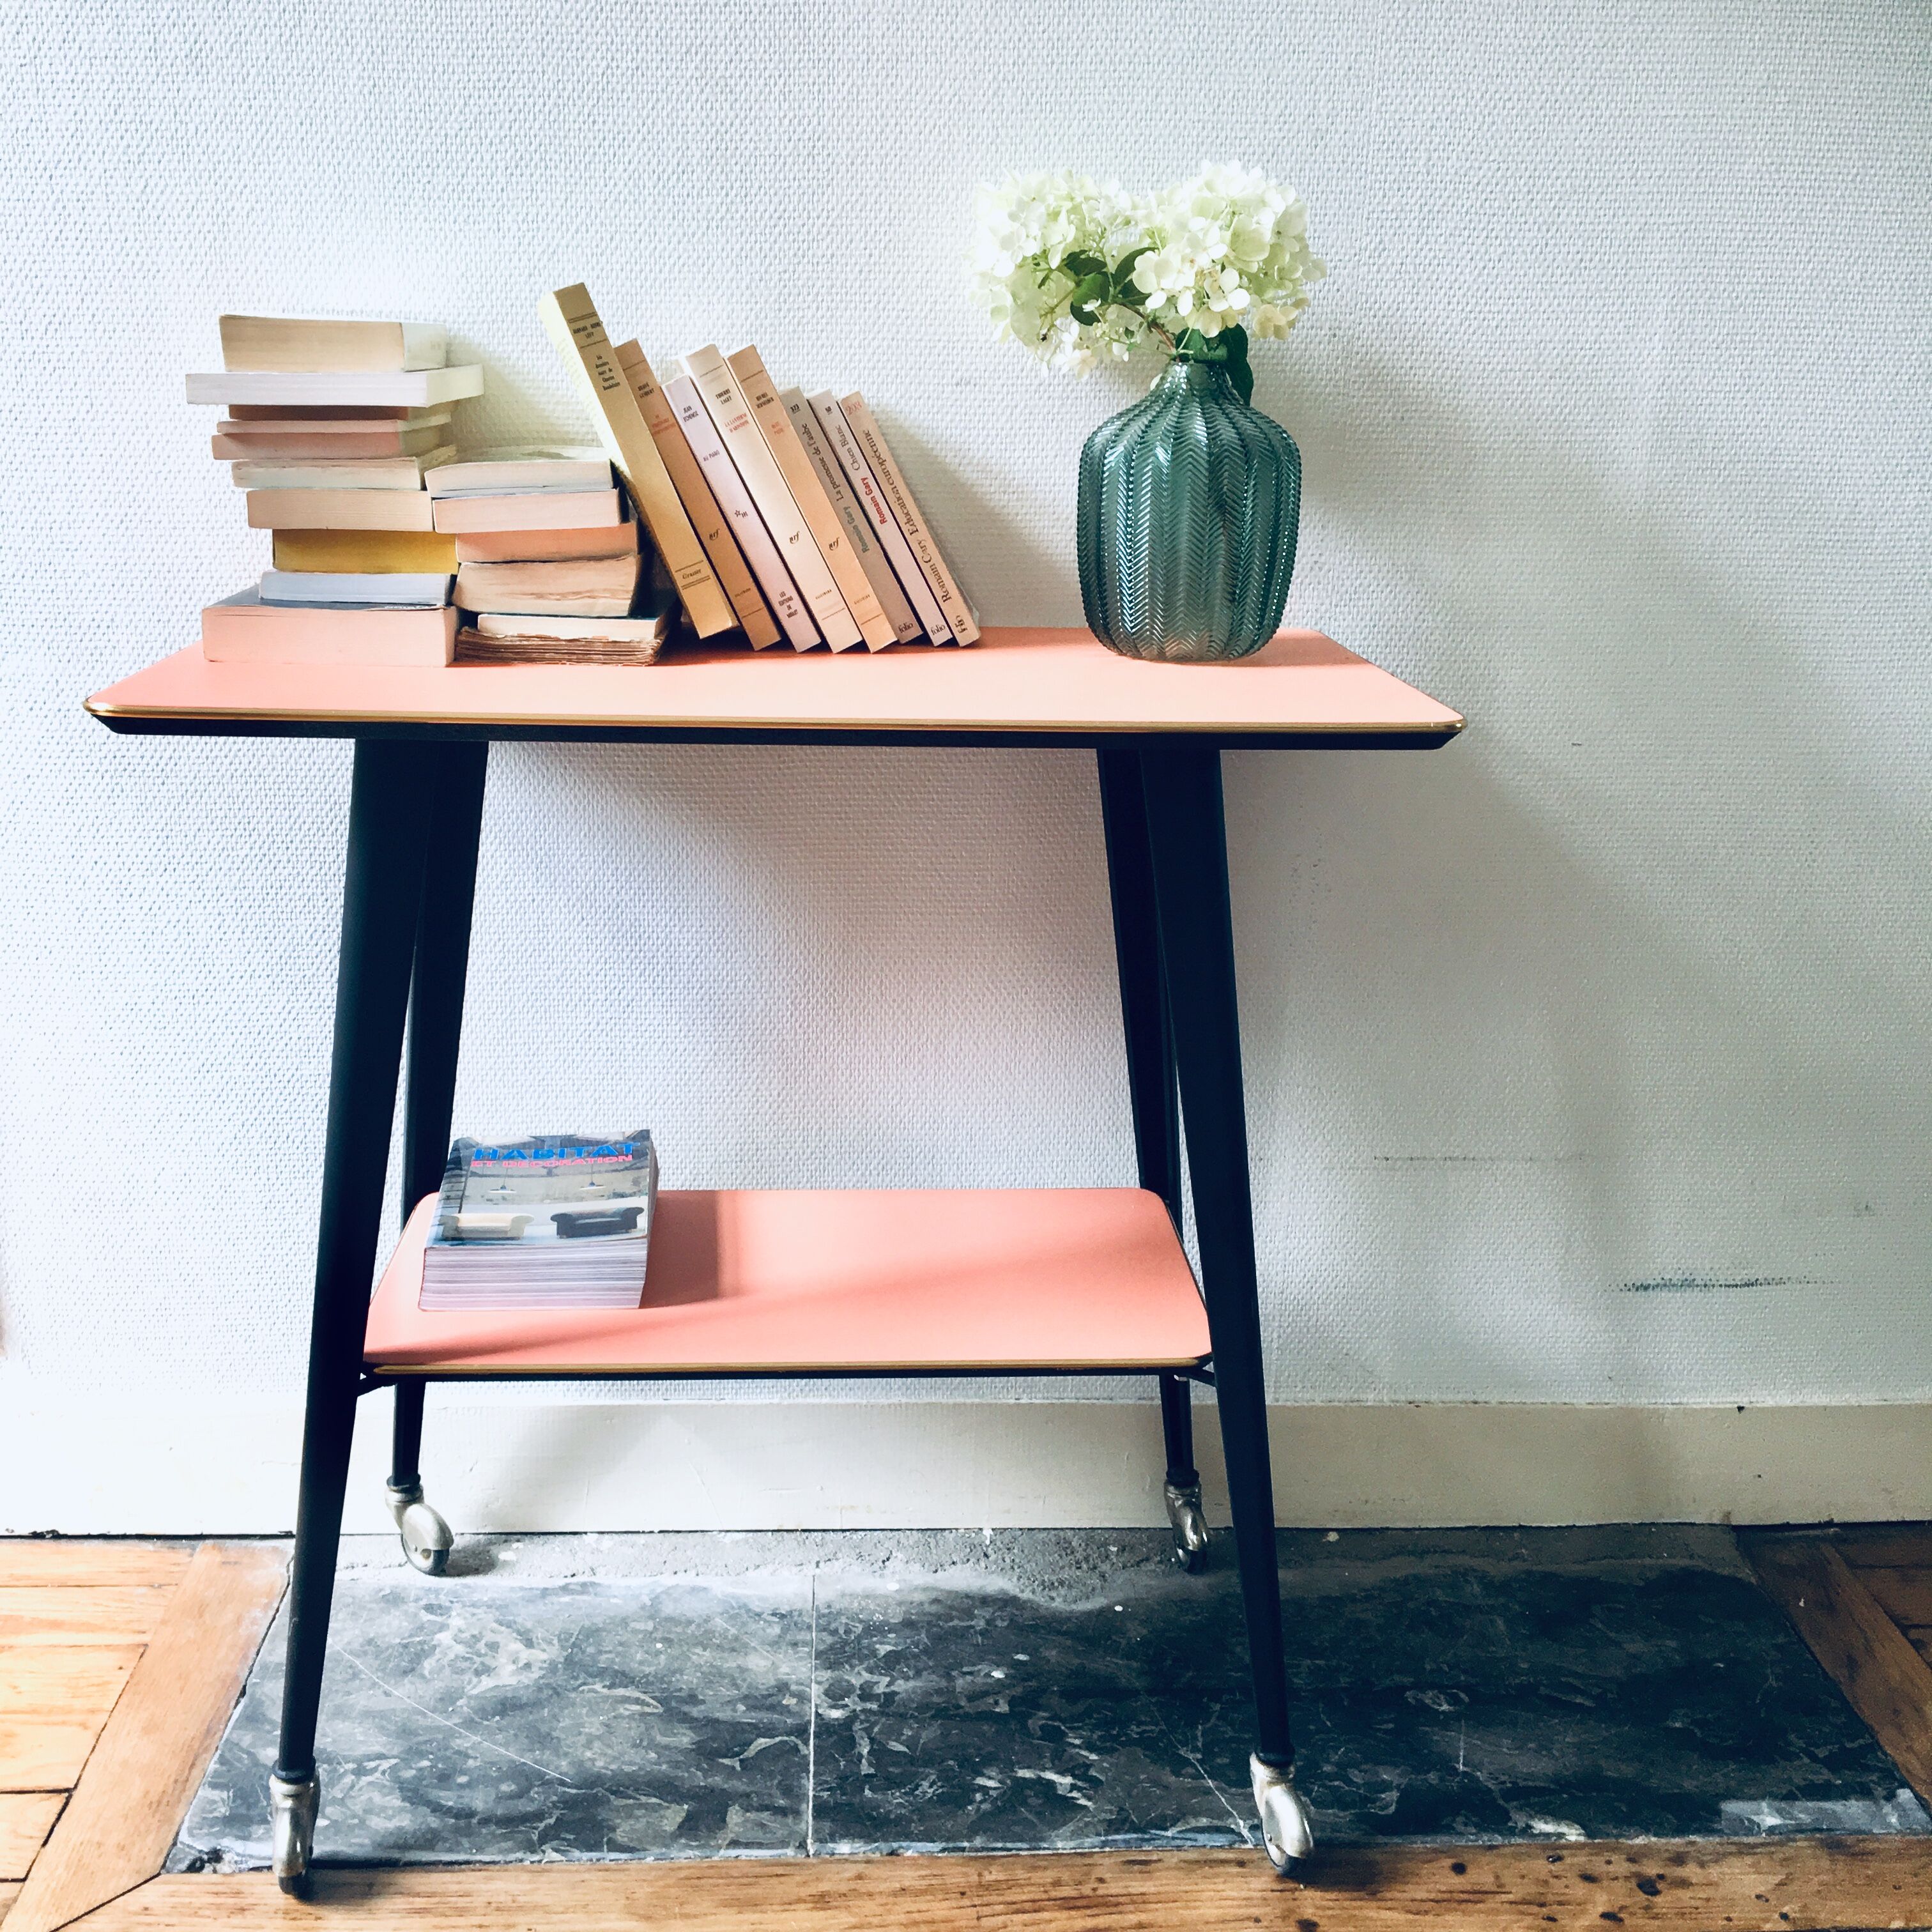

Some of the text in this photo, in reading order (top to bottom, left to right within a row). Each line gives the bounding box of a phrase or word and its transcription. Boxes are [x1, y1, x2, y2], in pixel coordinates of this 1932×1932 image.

[835, 424, 861, 471] Chien Blanc
[802, 422, 844, 502] La promesse de l'aube
[863, 429, 919, 535] Education européenne
[861, 477, 887, 525] Romain Gary
[843, 506, 856, 524] Gary
[790, 530, 800, 544] nrf
[829, 537, 840, 551] nrf
[929, 563, 952, 603] Romain
[897, 622, 914, 634] folio
[930, 624, 946, 636] folio
[473, 1142, 640, 1161] HABITAT
